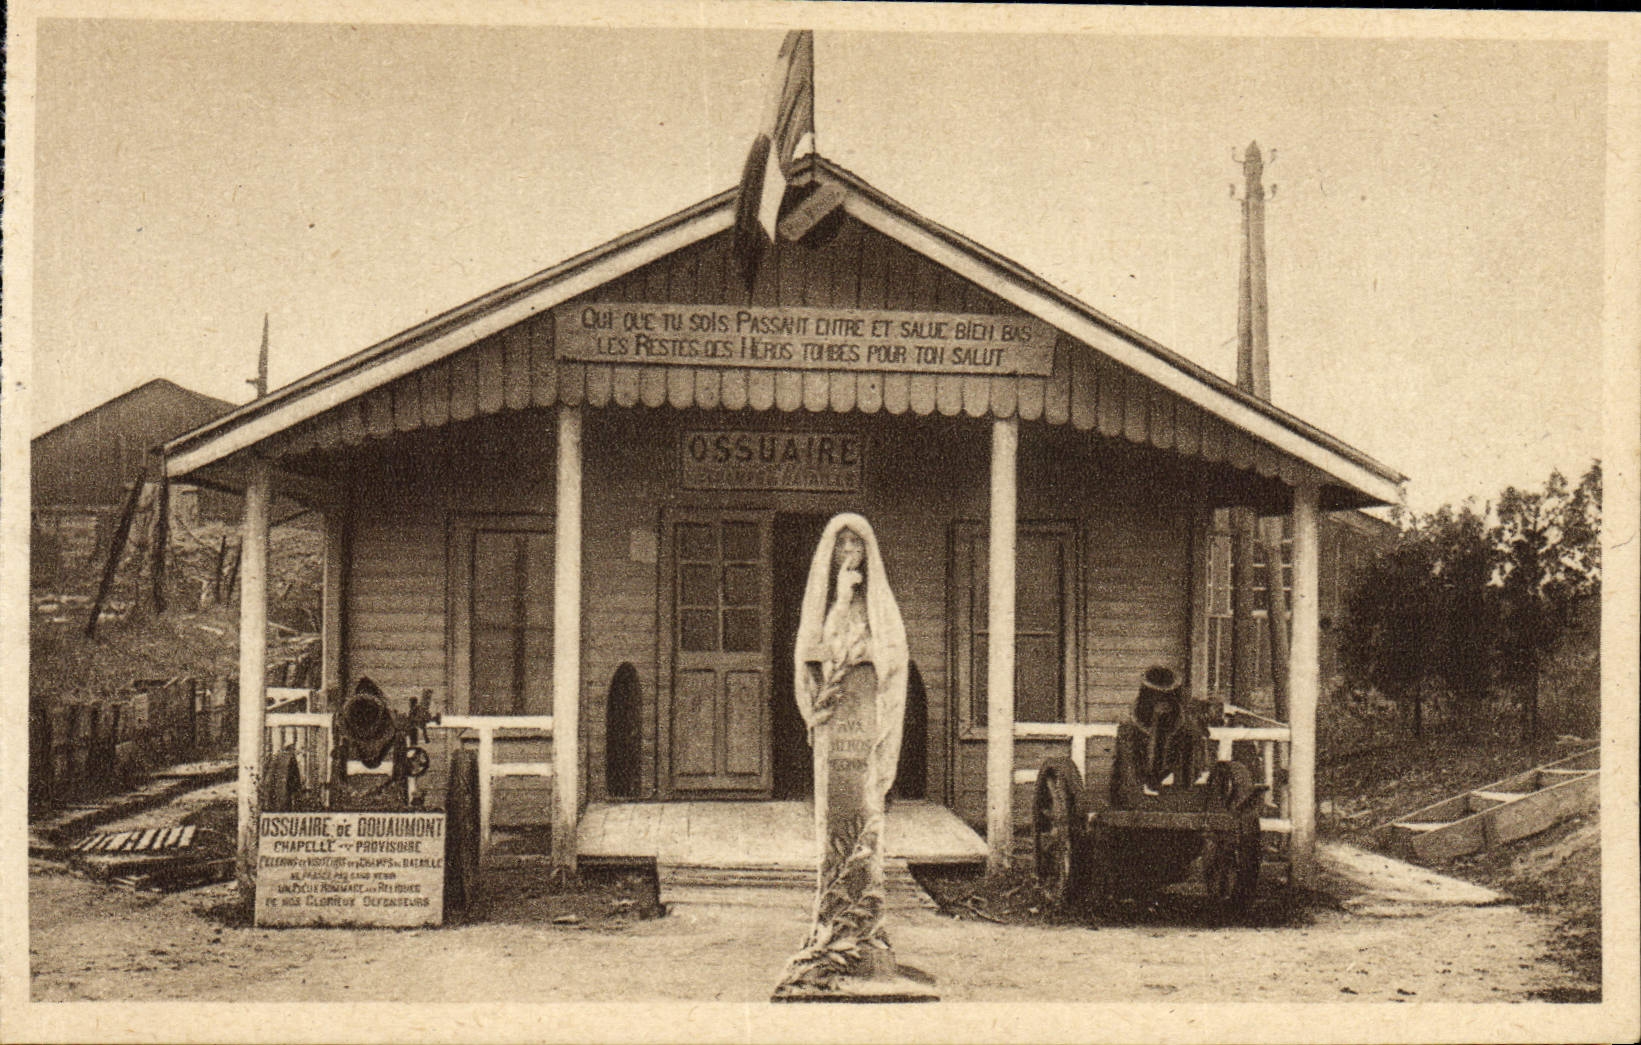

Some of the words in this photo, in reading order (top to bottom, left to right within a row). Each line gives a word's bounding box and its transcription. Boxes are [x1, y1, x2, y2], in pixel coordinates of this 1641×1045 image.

[581, 307, 613, 329] QUI
[624, 312, 656, 331] QUE
[662, 312, 683, 331] TU
[689, 311, 729, 333] SOIS
[736, 310, 809, 336] PASSANT
[815, 318, 865, 337] ENTRE
[871, 319, 894, 338] ET
[901, 321, 949, 340] SALUE
[955, 322, 995, 342] BIEN
[1001, 324, 1033, 343] BAS
[598, 336, 629, 356] LES
[635, 333, 700, 358] RESTES
[704, 339, 733, 358] DES
[867, 345, 907, 364] POUR
[916, 346, 944, 365] TON
[951, 347, 1004, 367] SALUT
[689, 435, 858, 466] OSSUAIRE
[261, 816, 332, 837] OSSUAIRE
[357, 817, 444, 838] DOUAUMONT
[274, 840, 336, 853] CHAPELLE
[356, 840, 422, 853] PROVISOIRE
